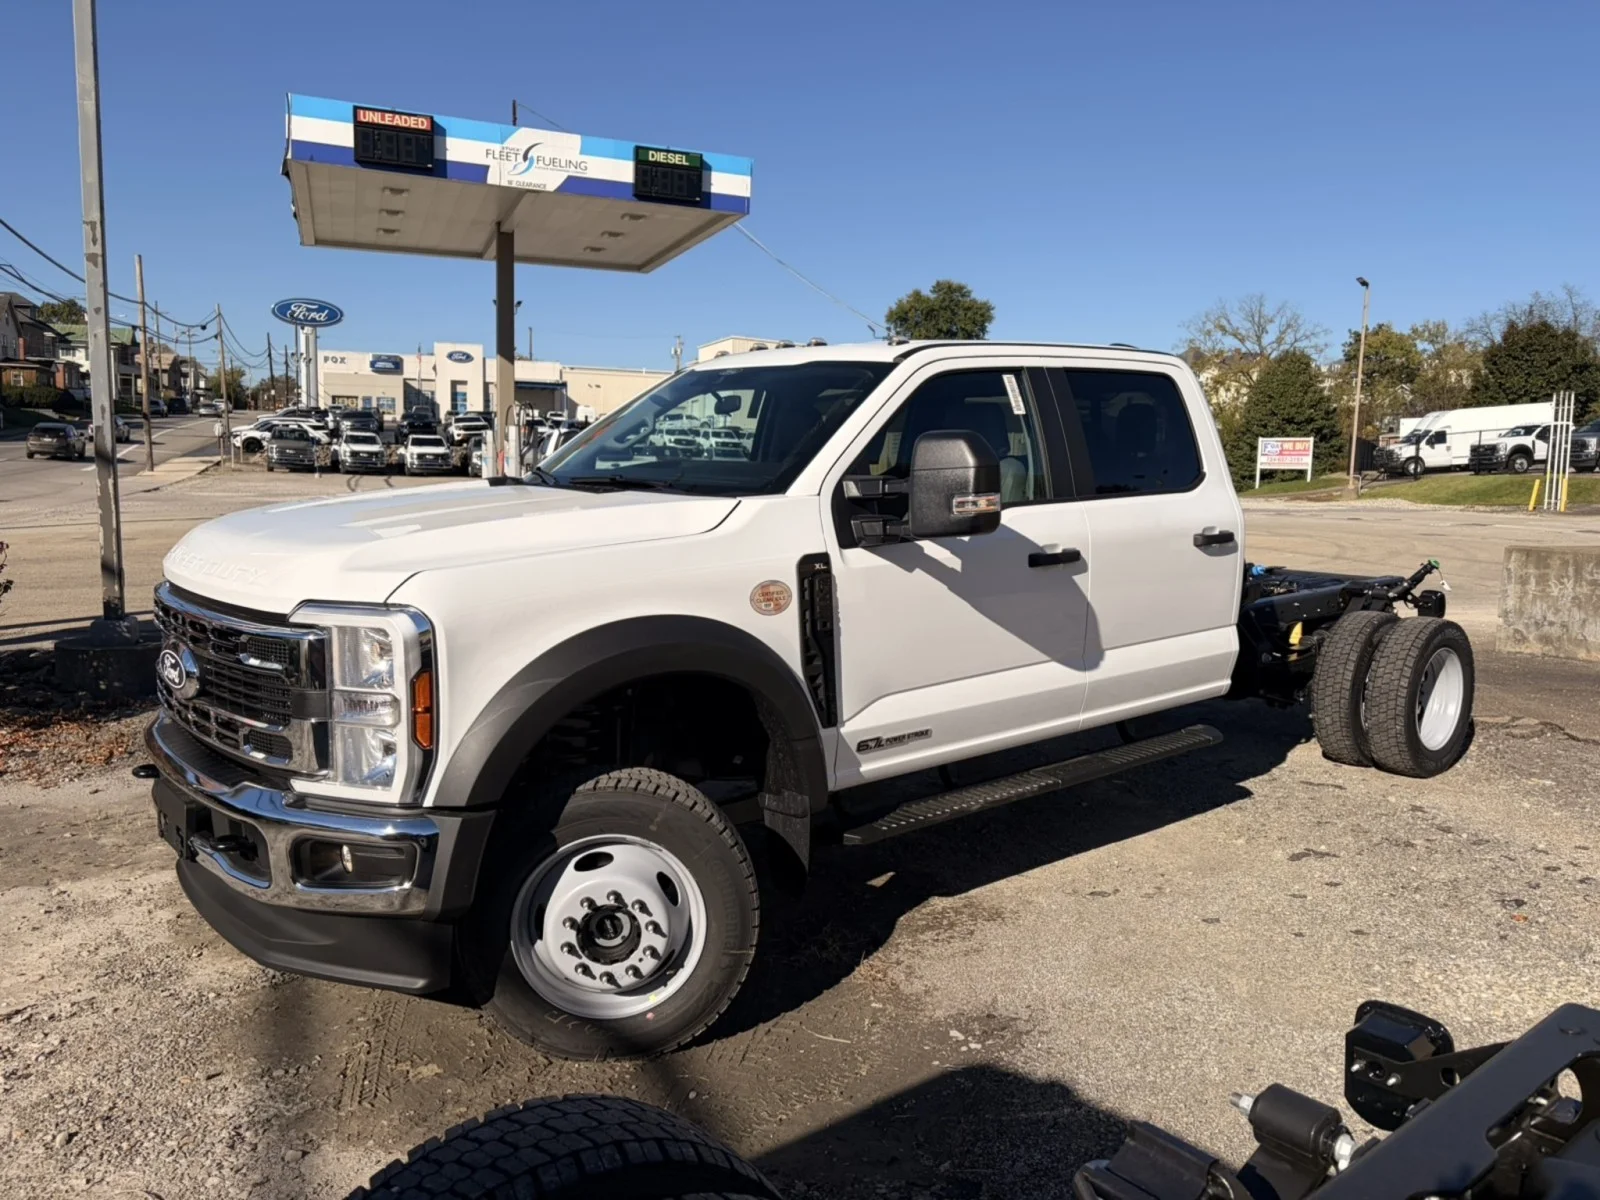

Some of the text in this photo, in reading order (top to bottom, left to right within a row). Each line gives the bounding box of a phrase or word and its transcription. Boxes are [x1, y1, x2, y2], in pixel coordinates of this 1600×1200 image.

[360, 110, 427, 129] UNLEADED
[485, 148, 521, 162] FLEET
[536, 155, 588, 171] FUELING
[648, 150, 690, 166] DIESEL
[515, 181, 546, 189] CLEARANCE
[287, 302, 329, 321] Ford
[323, 355, 347, 365] FOX
[451, 352, 468, 361] Ford
[164, 653, 180, 684] Ford
[856, 736, 884, 752] 6.7L
